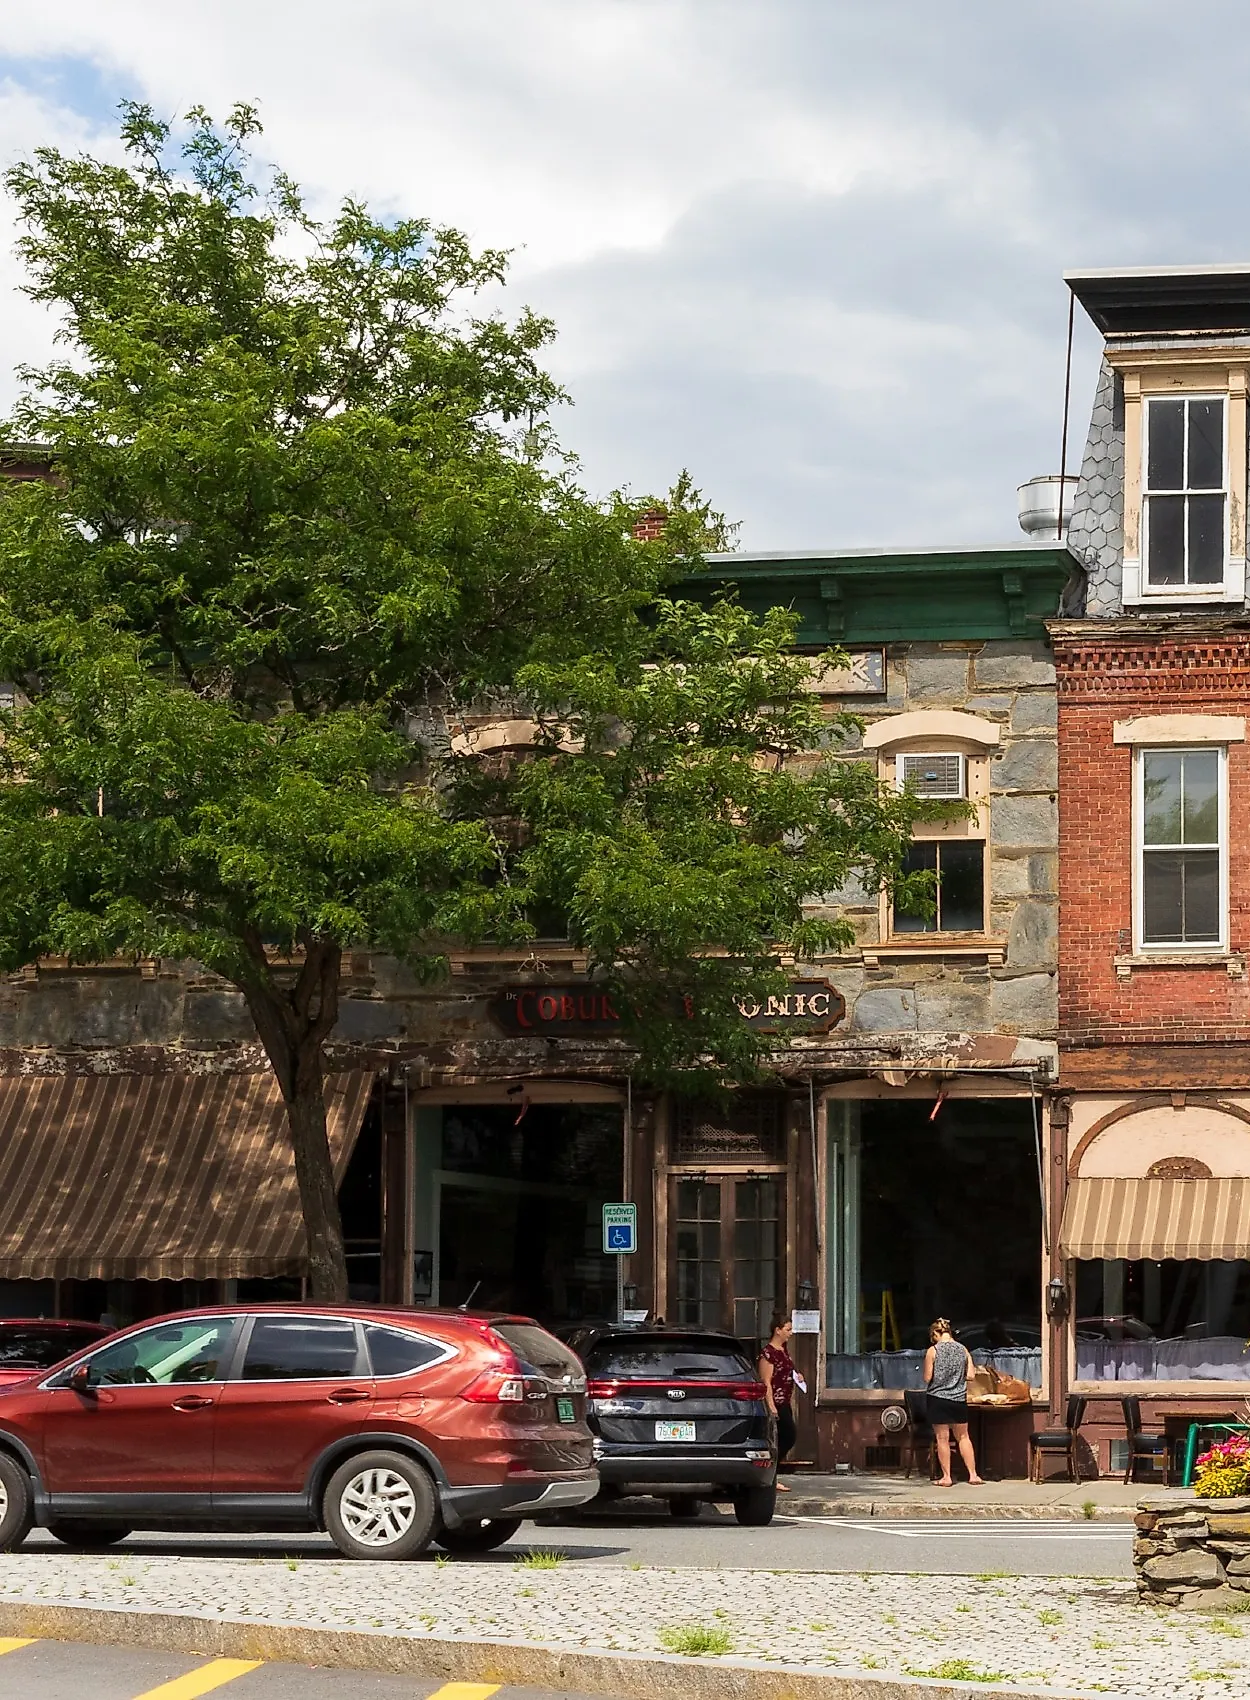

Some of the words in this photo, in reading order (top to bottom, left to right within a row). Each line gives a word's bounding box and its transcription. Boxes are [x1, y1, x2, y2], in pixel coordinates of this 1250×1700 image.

[732, 992, 830, 1019] ONIC
[605, 1207, 634, 1216] RESERVED
[607, 1216, 632, 1224] PARKING
